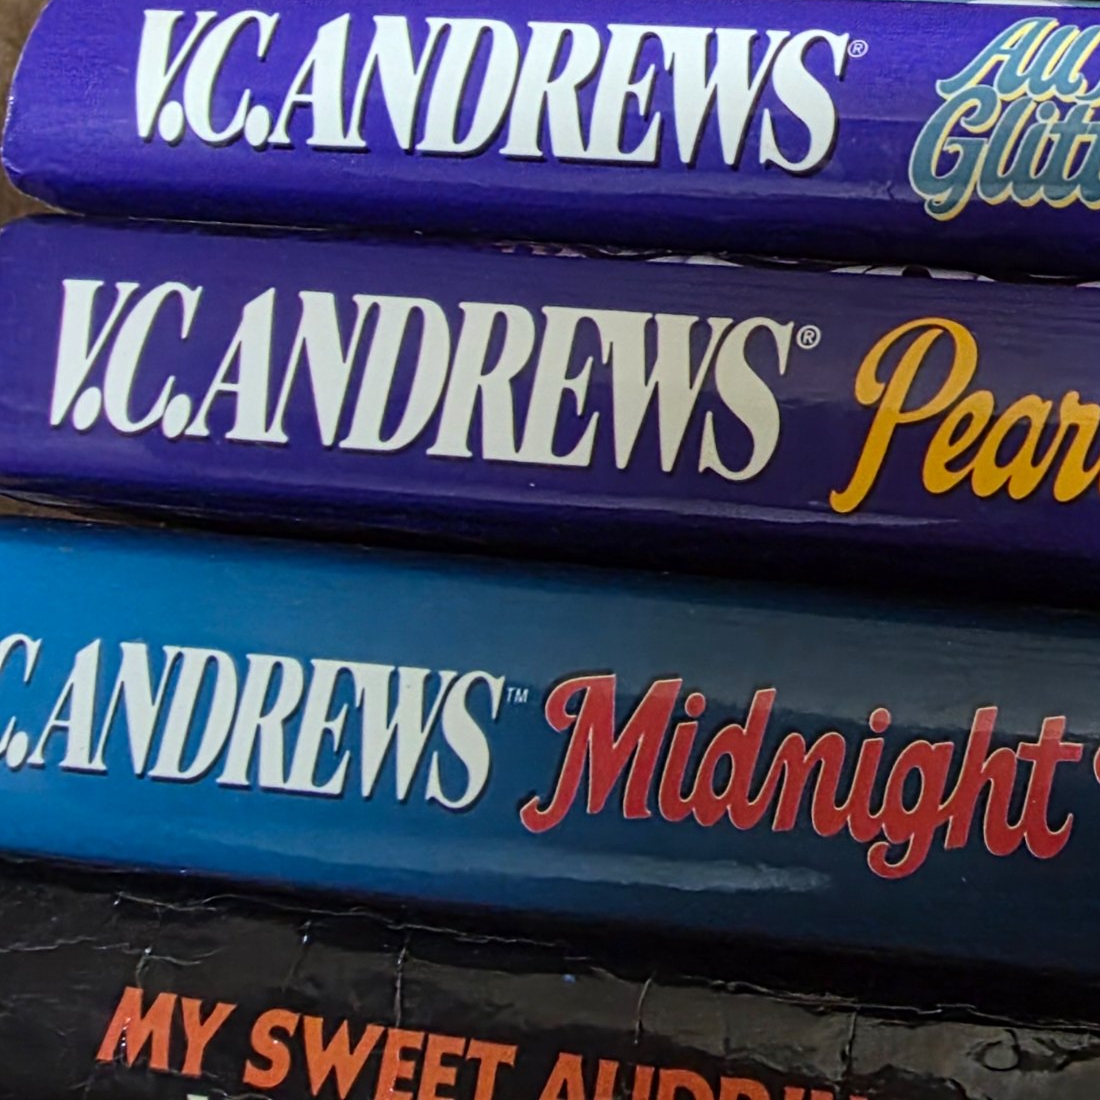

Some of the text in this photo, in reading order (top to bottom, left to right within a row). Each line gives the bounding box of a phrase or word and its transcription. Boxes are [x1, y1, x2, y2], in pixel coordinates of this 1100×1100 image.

[520, 674, 1083, 878] Midnight
[96, 986, 237, 1077] MY
[243, 1008, 518, 1100] SWEET
